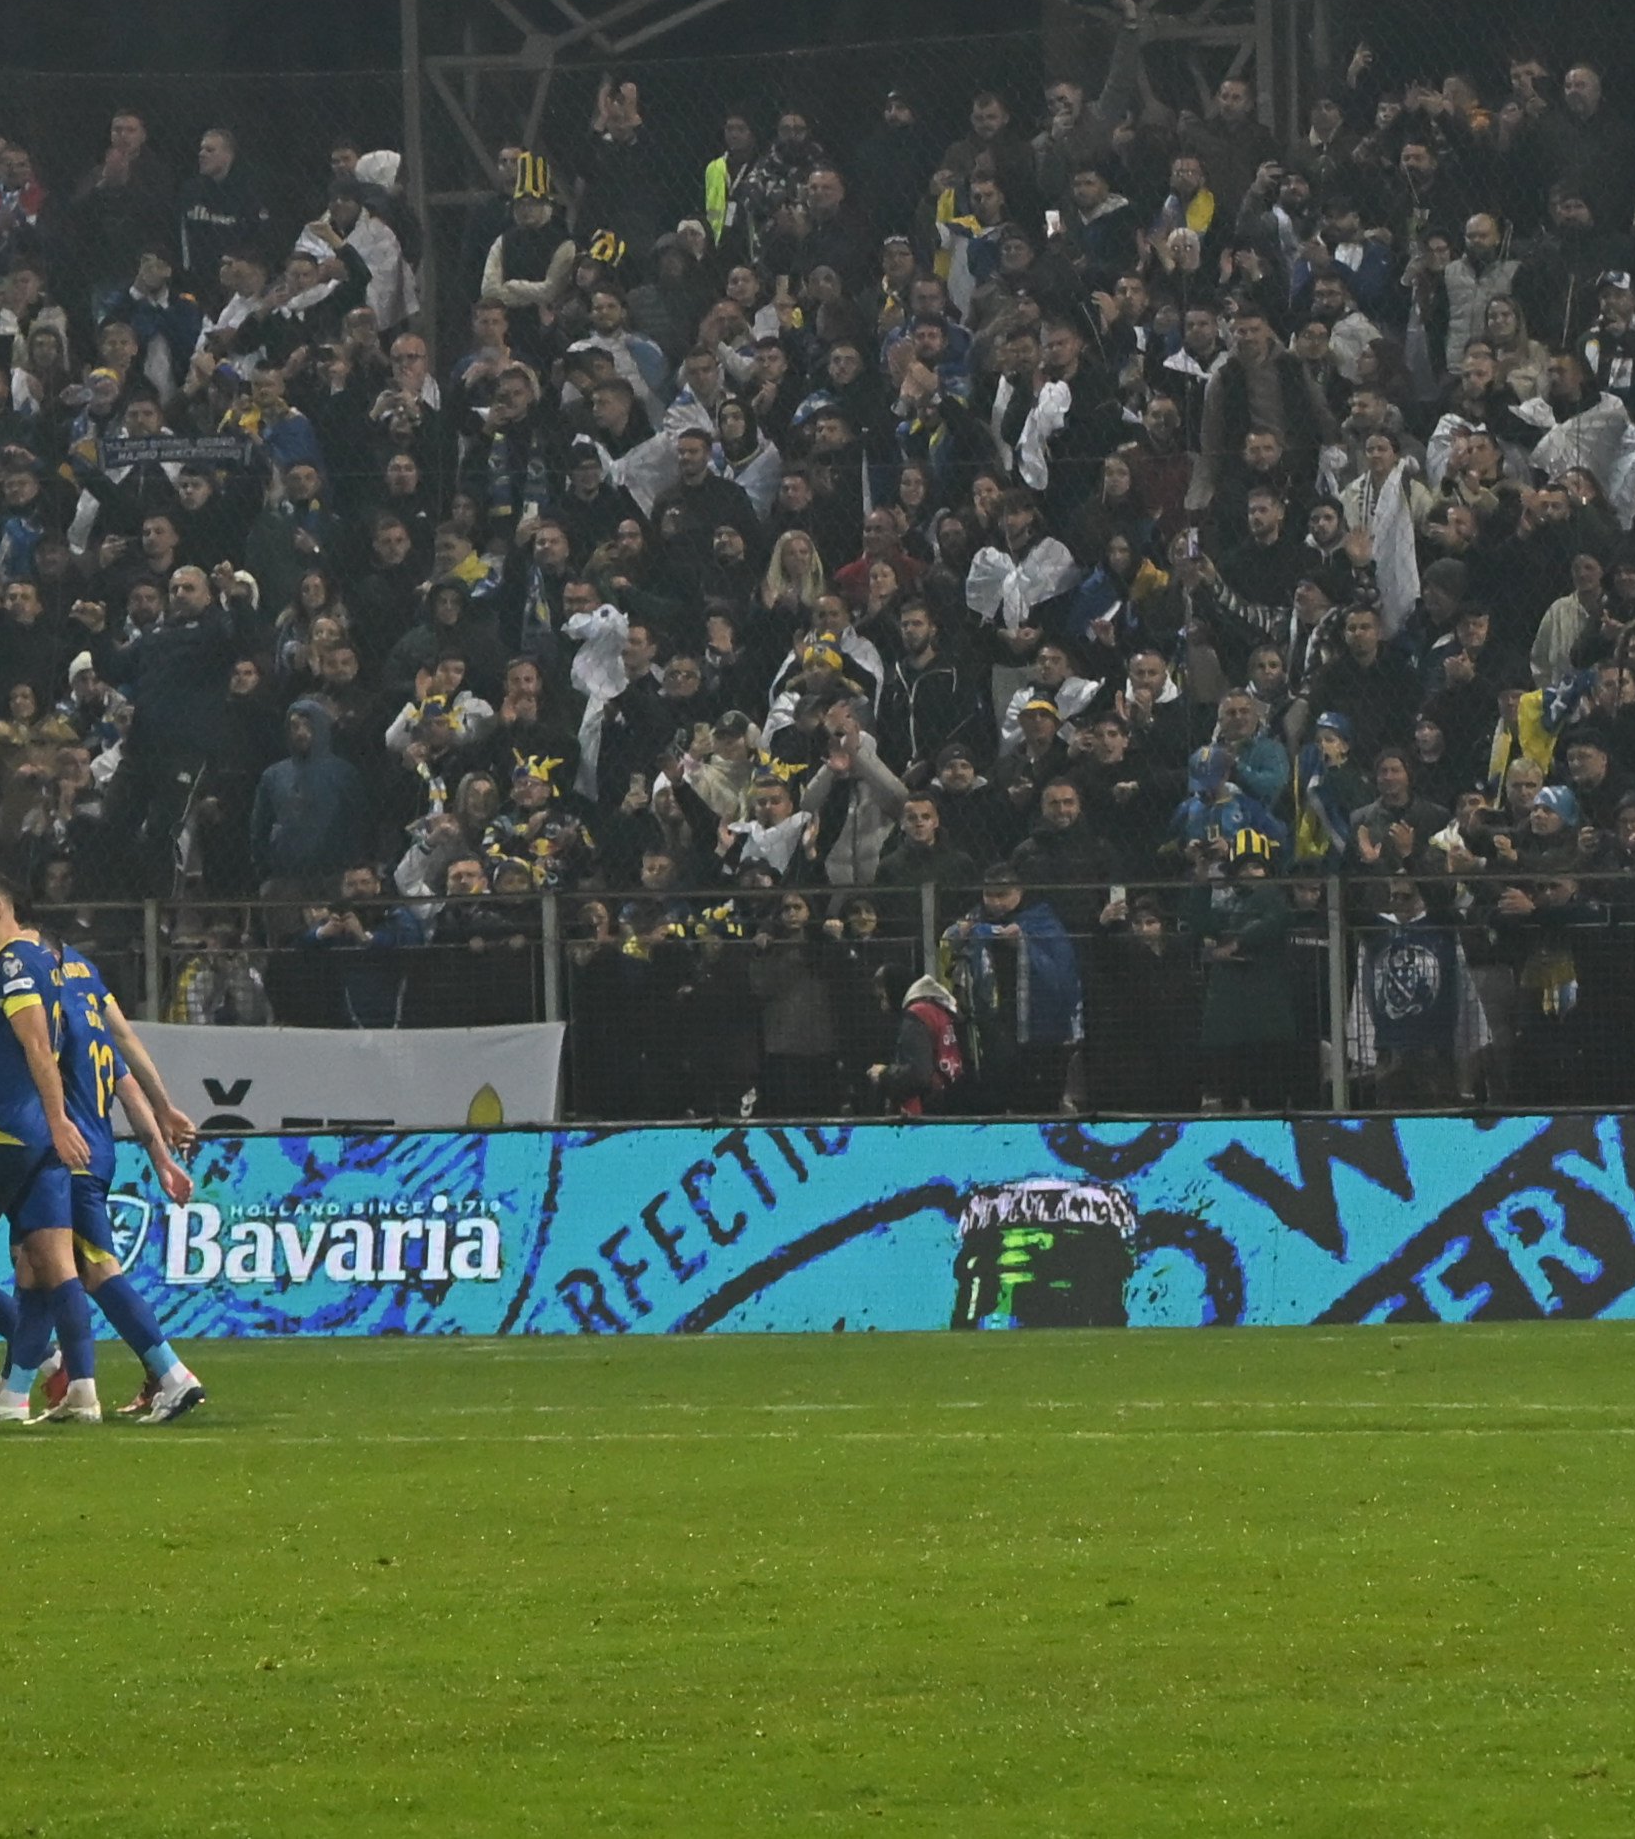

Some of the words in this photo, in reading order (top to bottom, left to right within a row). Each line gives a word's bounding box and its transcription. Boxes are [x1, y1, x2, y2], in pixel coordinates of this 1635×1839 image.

[230, 1204, 340, 1218] HOLLAND
[352, 1200, 425, 1215] SINCE
[165, 1202, 502, 1284] Bavaria
